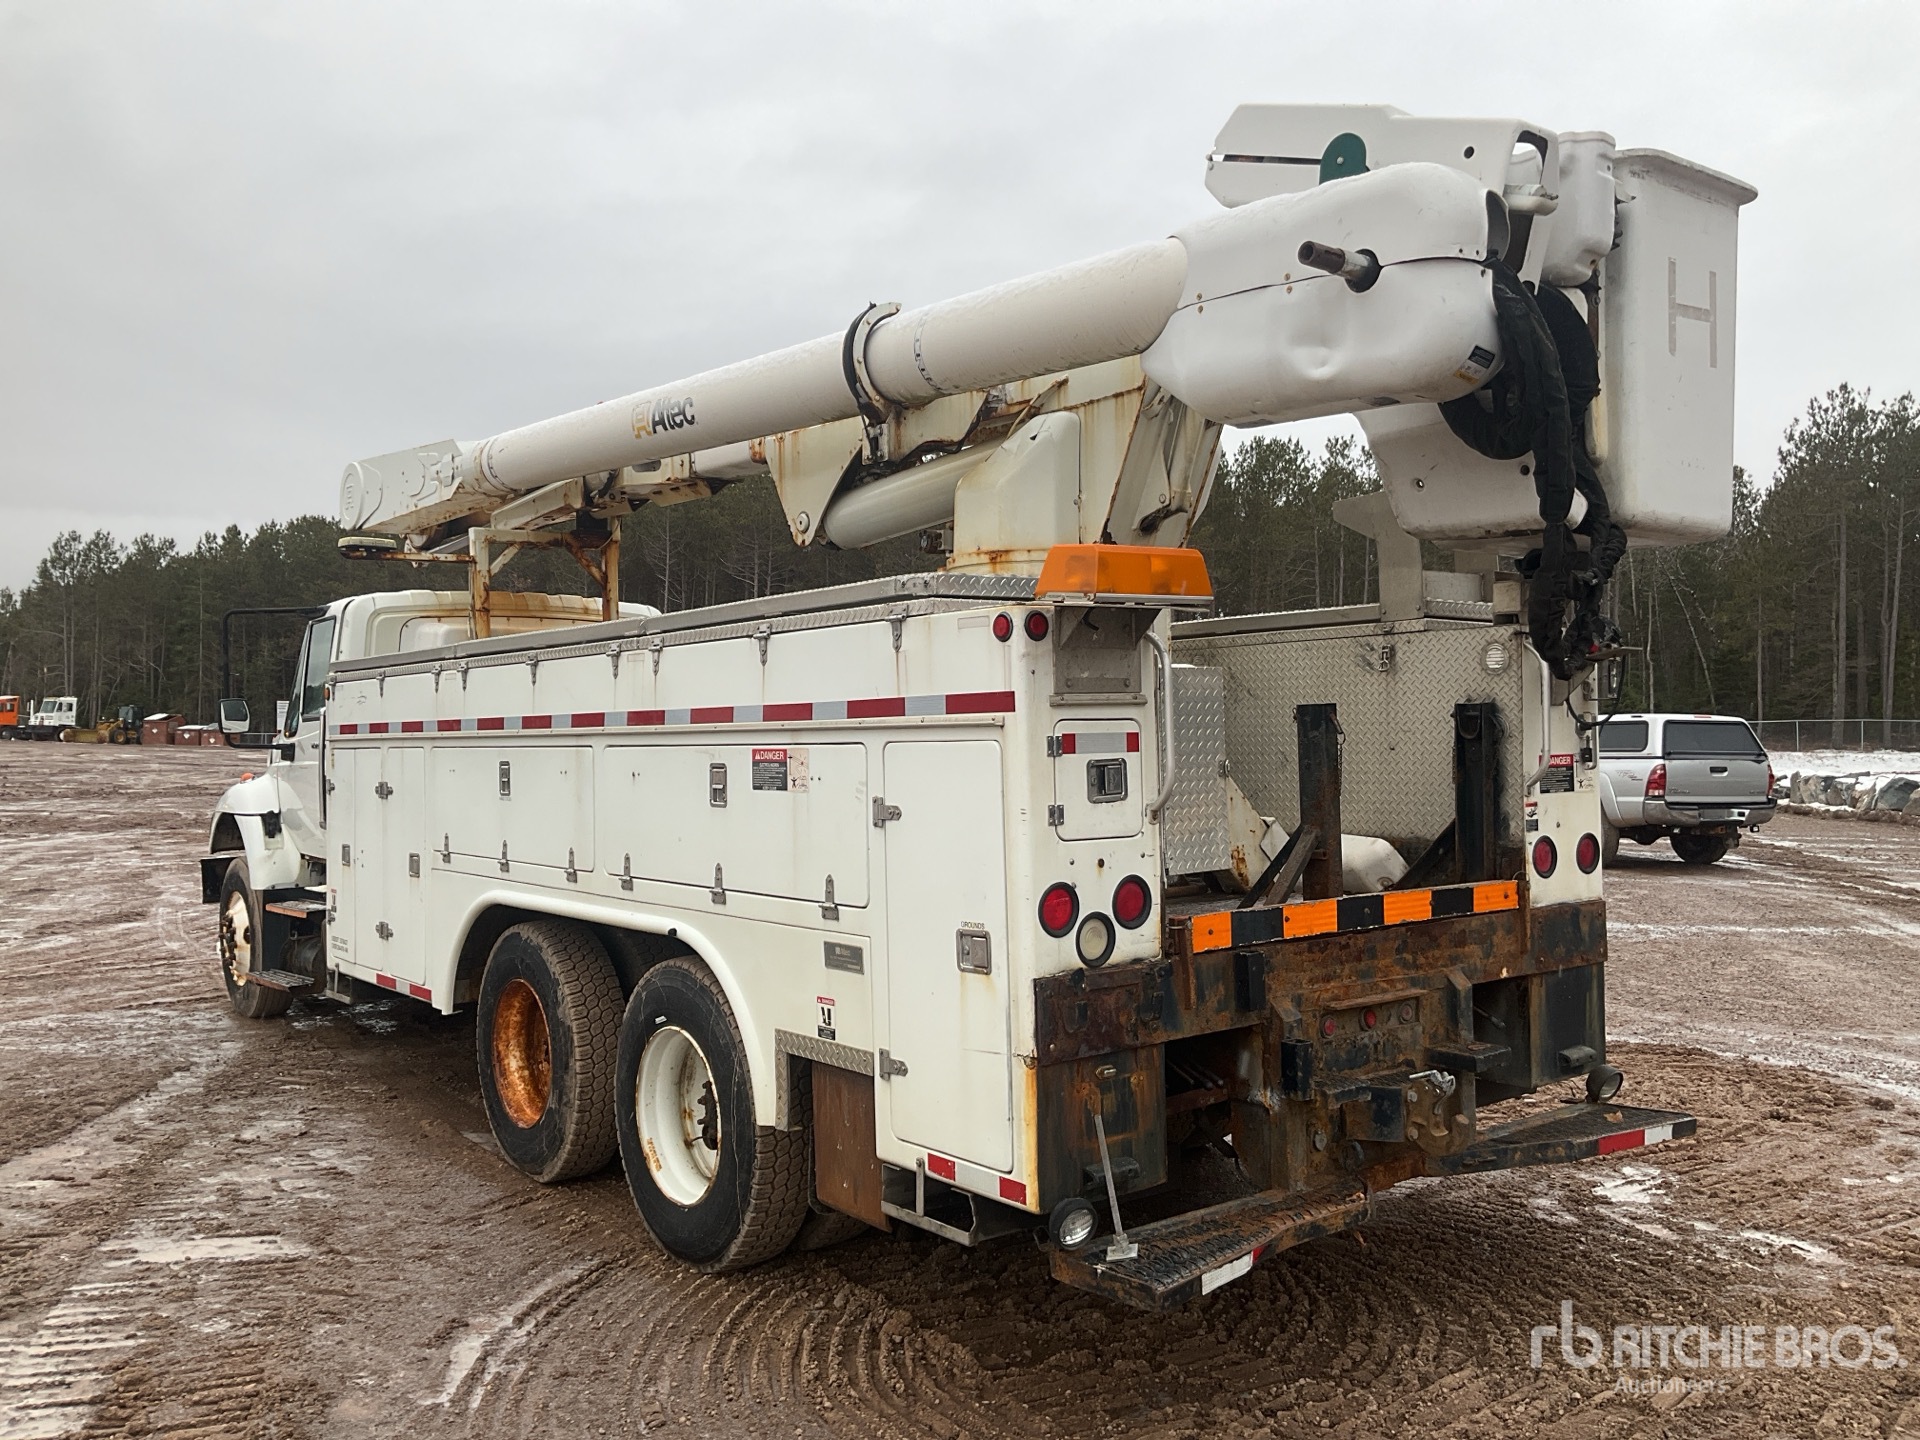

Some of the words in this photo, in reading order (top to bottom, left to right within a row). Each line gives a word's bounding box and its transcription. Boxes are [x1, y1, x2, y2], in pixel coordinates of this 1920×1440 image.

[1667, 256, 1717, 368] H
[760, 751, 785, 760] DANGER
[1549, 756, 1571, 765] ANGER
[960, 921, 985, 930] GROUNDS
